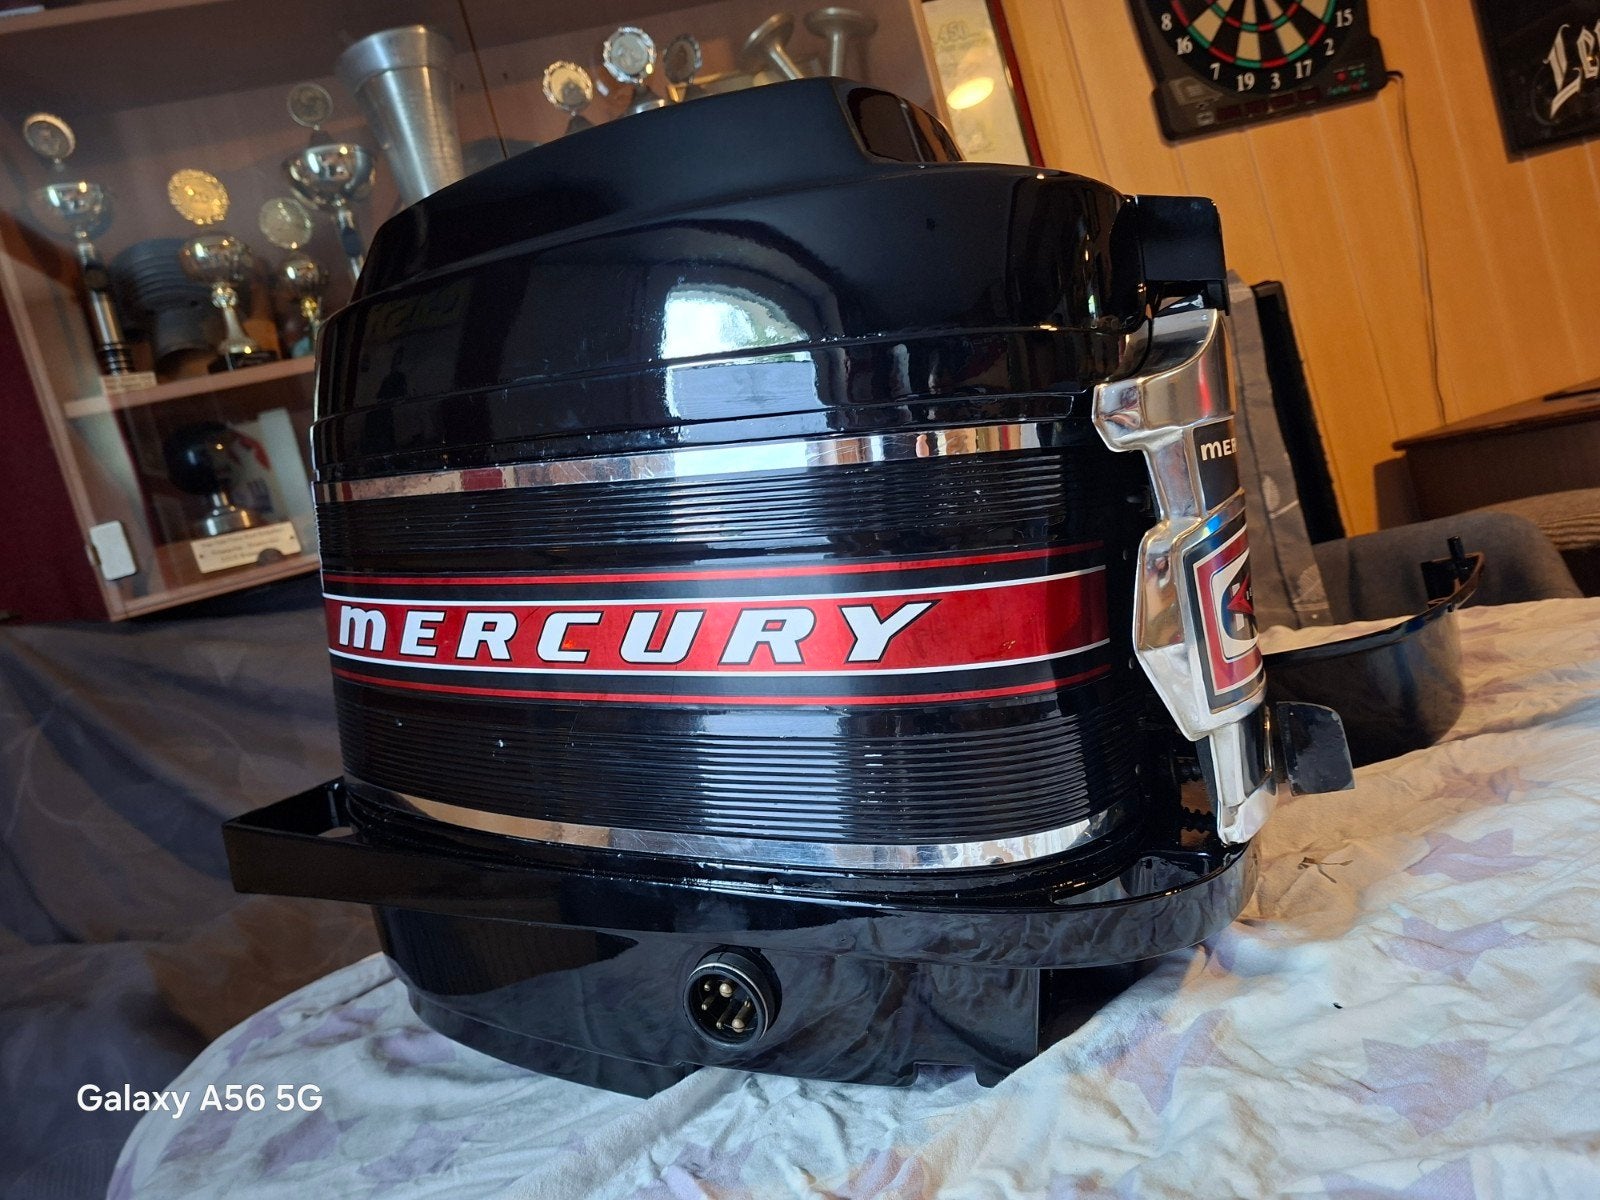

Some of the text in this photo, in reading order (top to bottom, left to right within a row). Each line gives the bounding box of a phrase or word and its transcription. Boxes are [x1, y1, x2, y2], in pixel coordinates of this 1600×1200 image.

[1161, 12, 1172, 31] 8
[1335, 8, 1353, 28] 15
[1176, 35, 1193, 56] 16
[1323, 38, 1335, 56] 2
[1210, 62, 1220, 80] 7
[1295, 59, 1312, 79] 17
[1236, 72, 1255, 92] 19
[1270, 72, 1281, 90] 3
